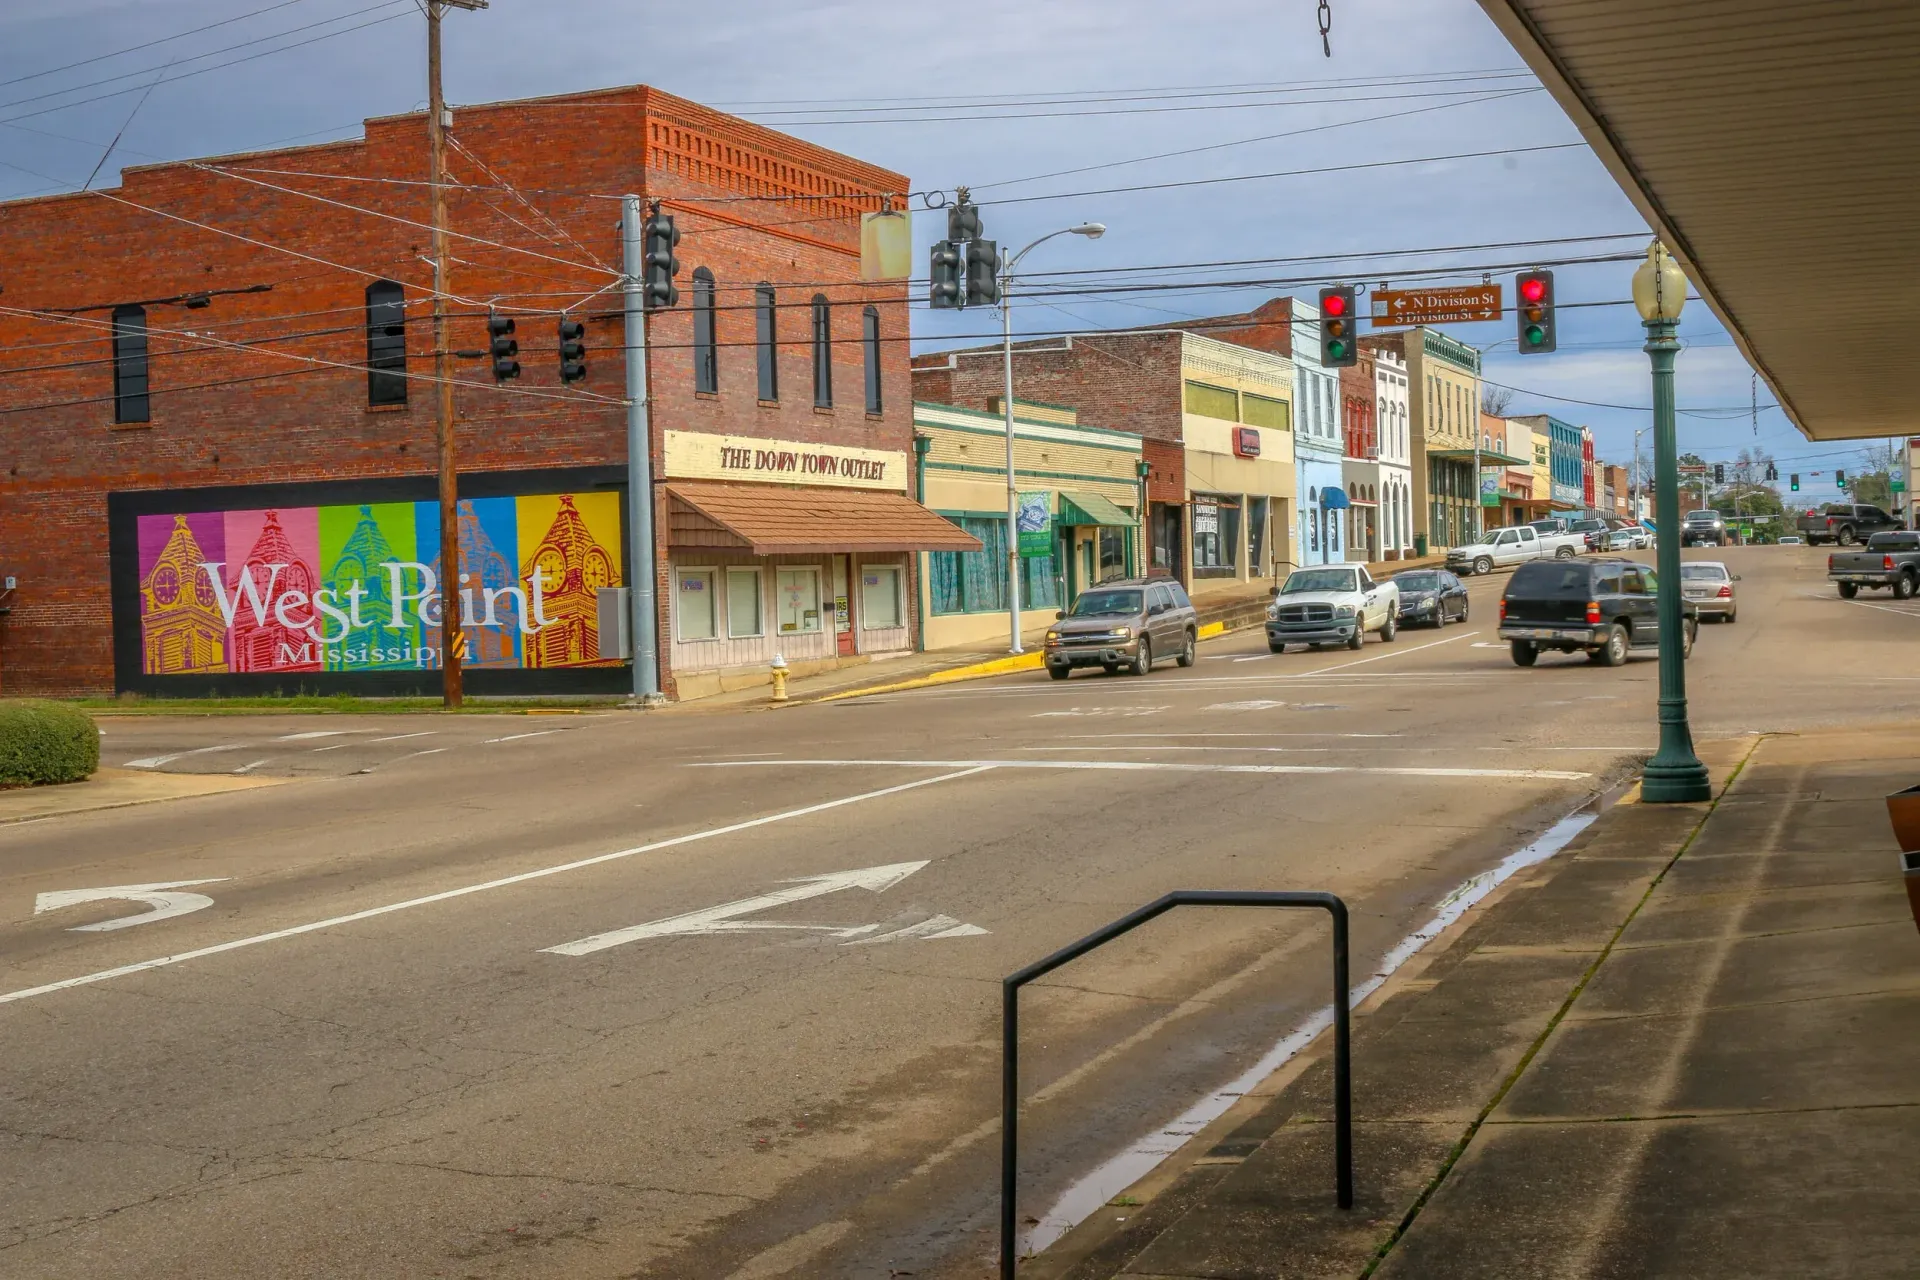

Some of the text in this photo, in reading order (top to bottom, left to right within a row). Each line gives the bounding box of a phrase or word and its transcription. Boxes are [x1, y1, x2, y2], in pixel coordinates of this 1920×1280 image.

[1413, 292, 1494, 308] N Division St
[1395, 308, 1474, 323] S Division St
[720, 446, 886, 480] THE DOWN TOWN OUTLET
[198, 562, 559, 643] West Point
[836, 602, 847, 611] IRS
[276, 640, 473, 668] Mississipi
